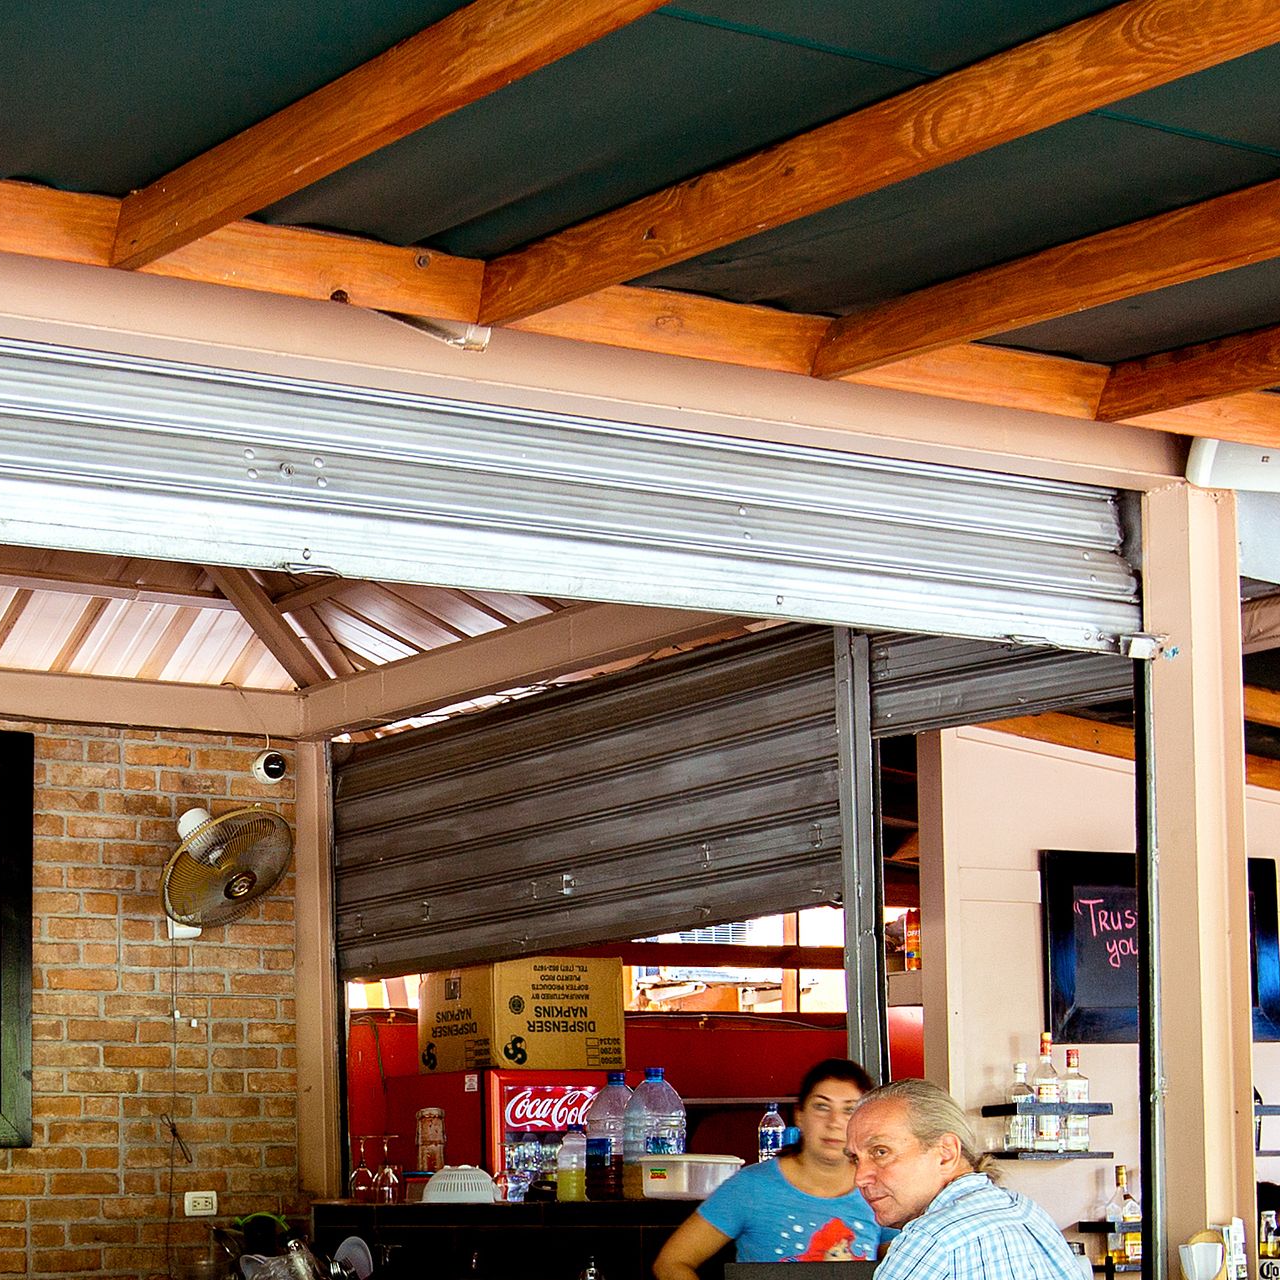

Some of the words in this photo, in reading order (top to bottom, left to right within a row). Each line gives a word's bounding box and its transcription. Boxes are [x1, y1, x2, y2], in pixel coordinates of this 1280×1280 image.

[531, 983, 565, 991] PRODUCTS
[435, 1008, 472, 1023] NAPKINS
[534, 1005, 588, 1018] NAPKINS
[431, 1021, 477, 1038] DISPENSER
[527, 1020, 596, 1033] DISPENSER
